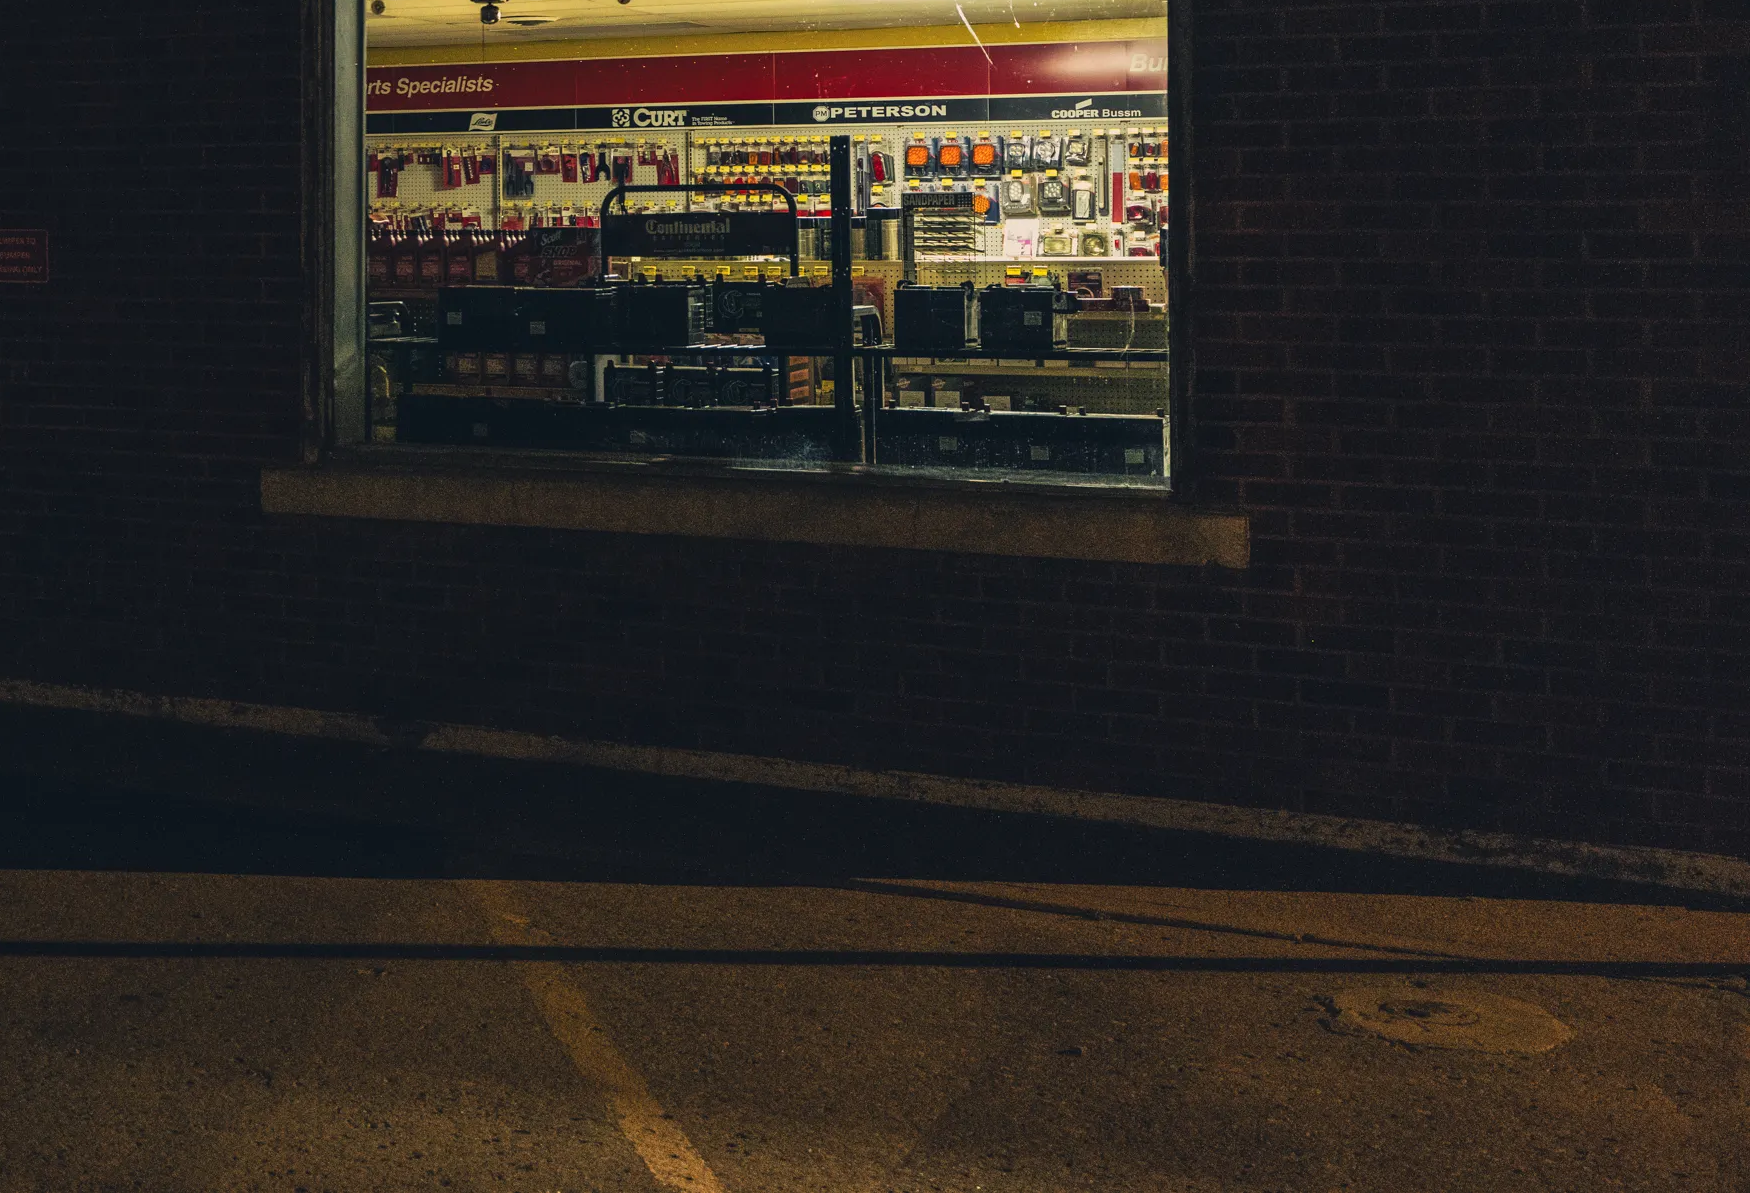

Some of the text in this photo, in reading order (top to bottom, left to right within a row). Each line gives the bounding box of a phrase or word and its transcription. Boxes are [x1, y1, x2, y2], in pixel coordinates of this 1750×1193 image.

[396, 75, 493, 98] Specialists
[633, 108, 687, 127] CURT
[830, 104, 947, 119] PETERSON
[1051, 109, 1099, 119] COOPER
[903, 194, 955, 206] SANDPAPER
[645, 217, 730, 234] Continental
